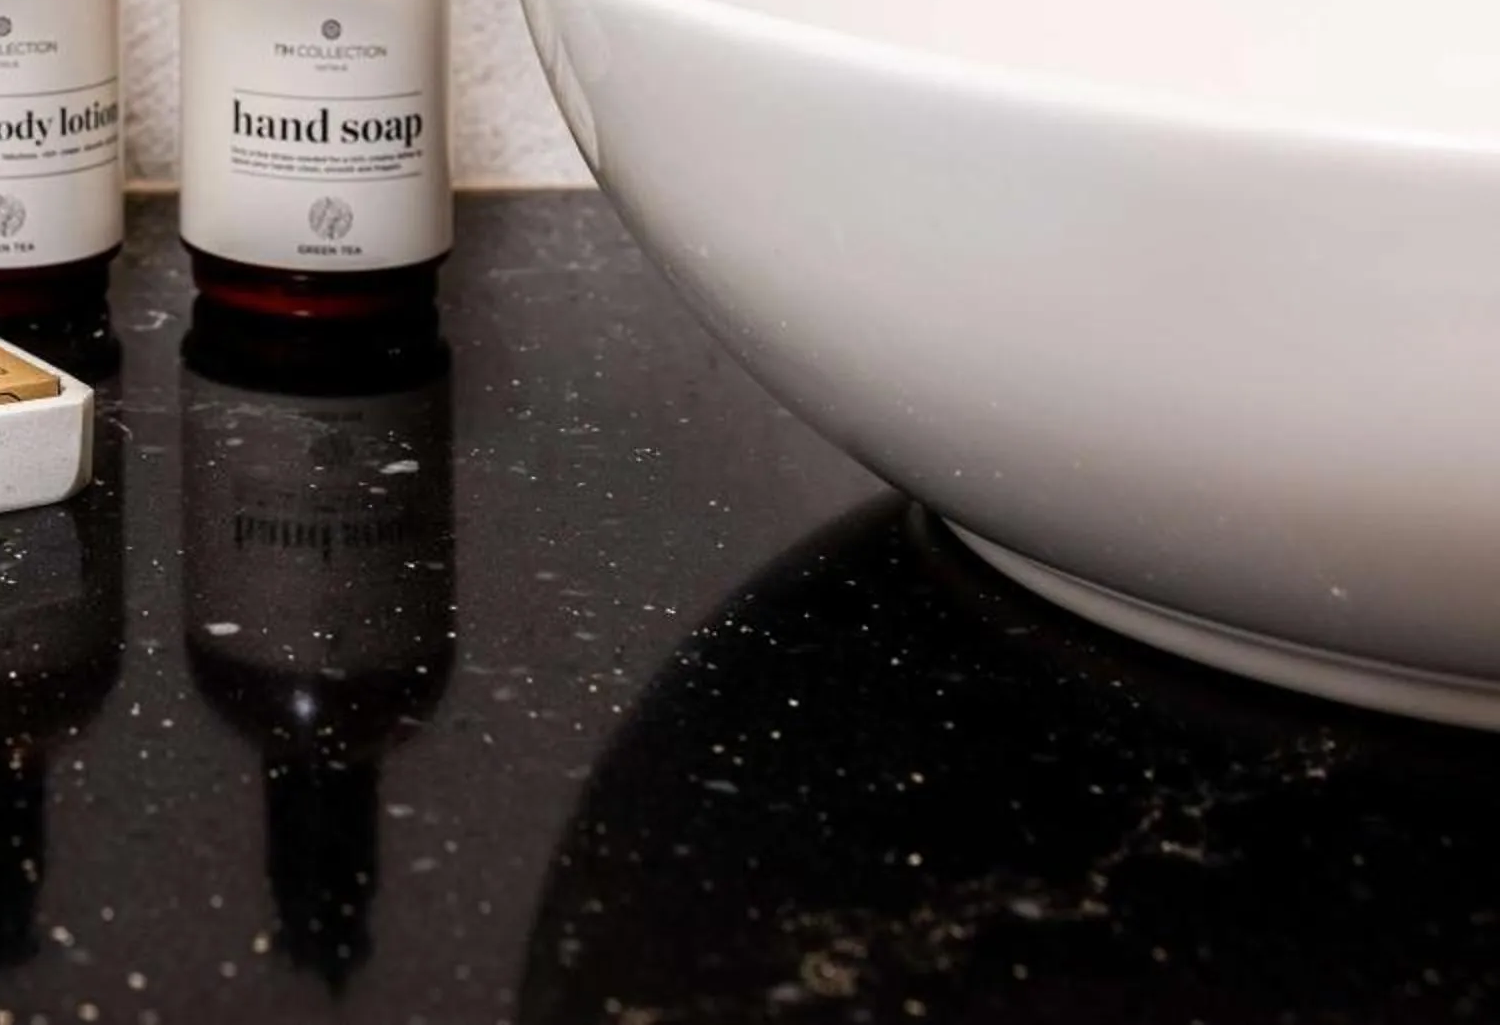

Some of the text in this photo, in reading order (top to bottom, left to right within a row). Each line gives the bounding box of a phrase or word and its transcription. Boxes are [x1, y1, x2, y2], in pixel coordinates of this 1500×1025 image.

[297, 45, 387, 60] COLLECTION
[233, 98, 423, 148] hand soap
[14, 242, 35, 253] TEA
[297, 244, 363, 256] GREEN TEA
